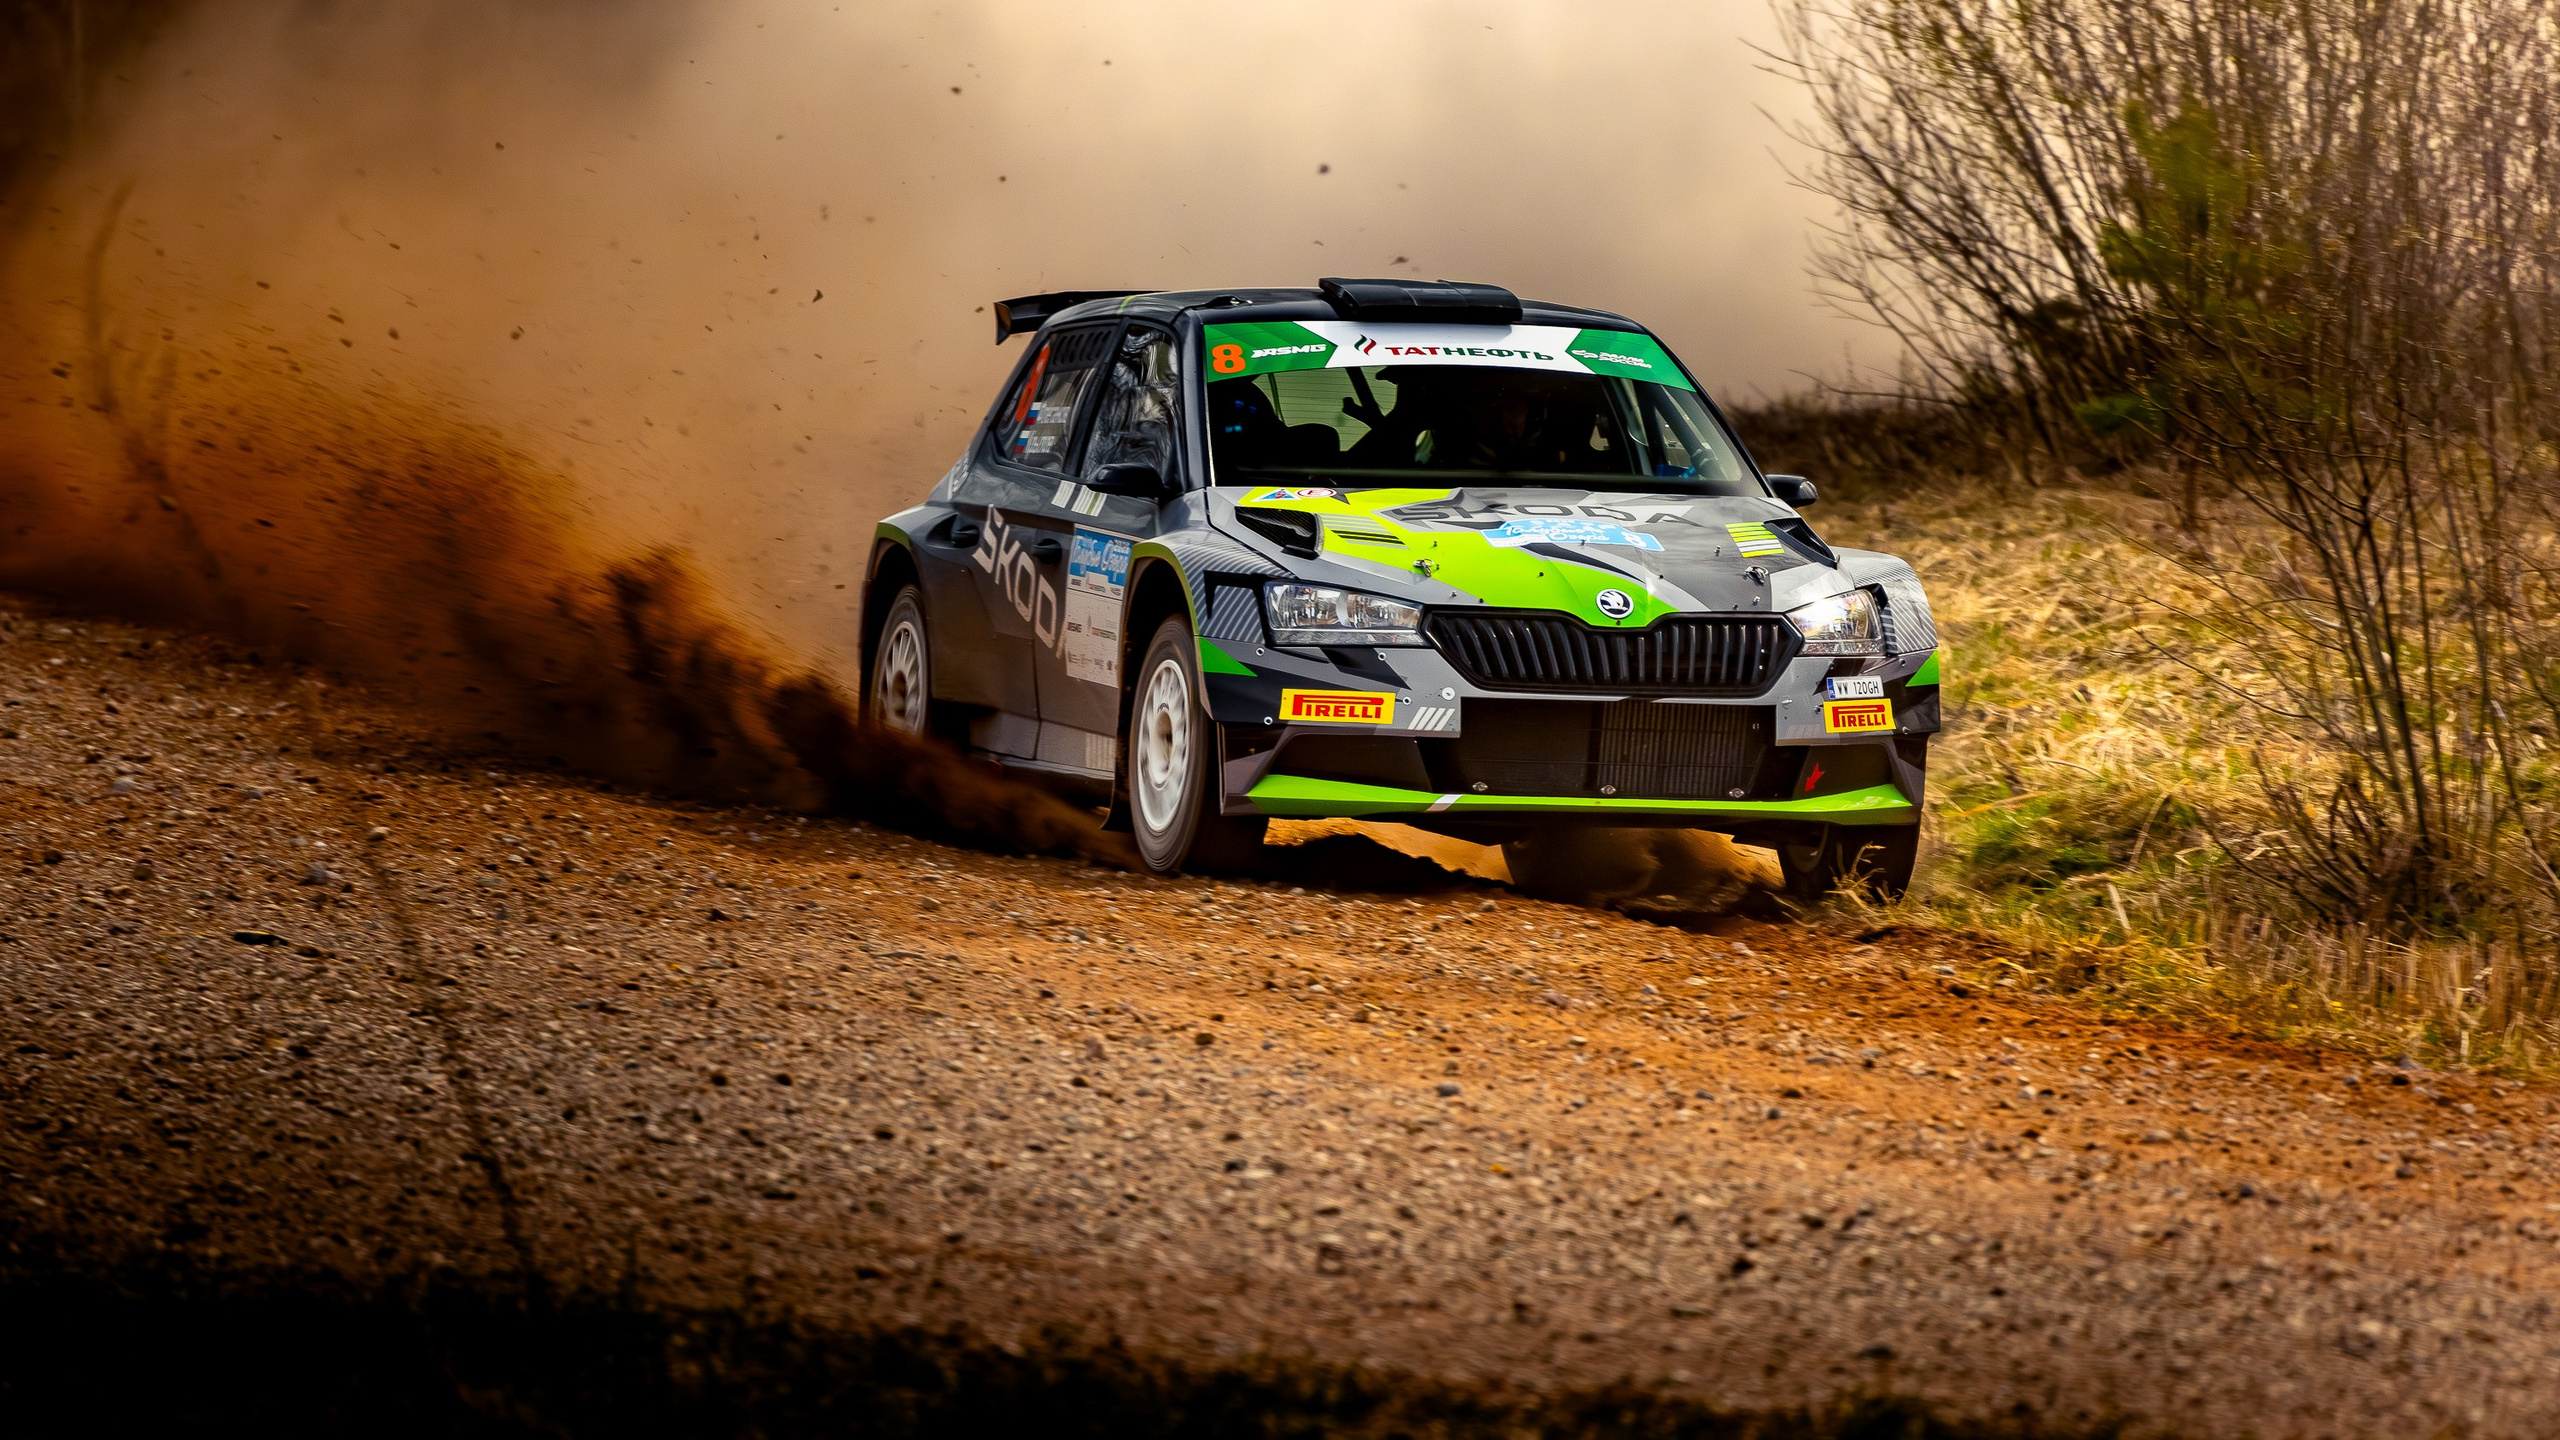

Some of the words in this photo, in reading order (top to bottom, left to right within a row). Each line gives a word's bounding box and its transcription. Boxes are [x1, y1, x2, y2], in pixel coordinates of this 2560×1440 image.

[1211, 344, 1246, 374] 8
[1384, 347, 1554, 361] ТАТНЕФТЬ
[1853, 681, 1879, 694] 120GH
[1292, 694, 1384, 719] PIRELLI
[1832, 704, 1886, 728] PIRELLI
